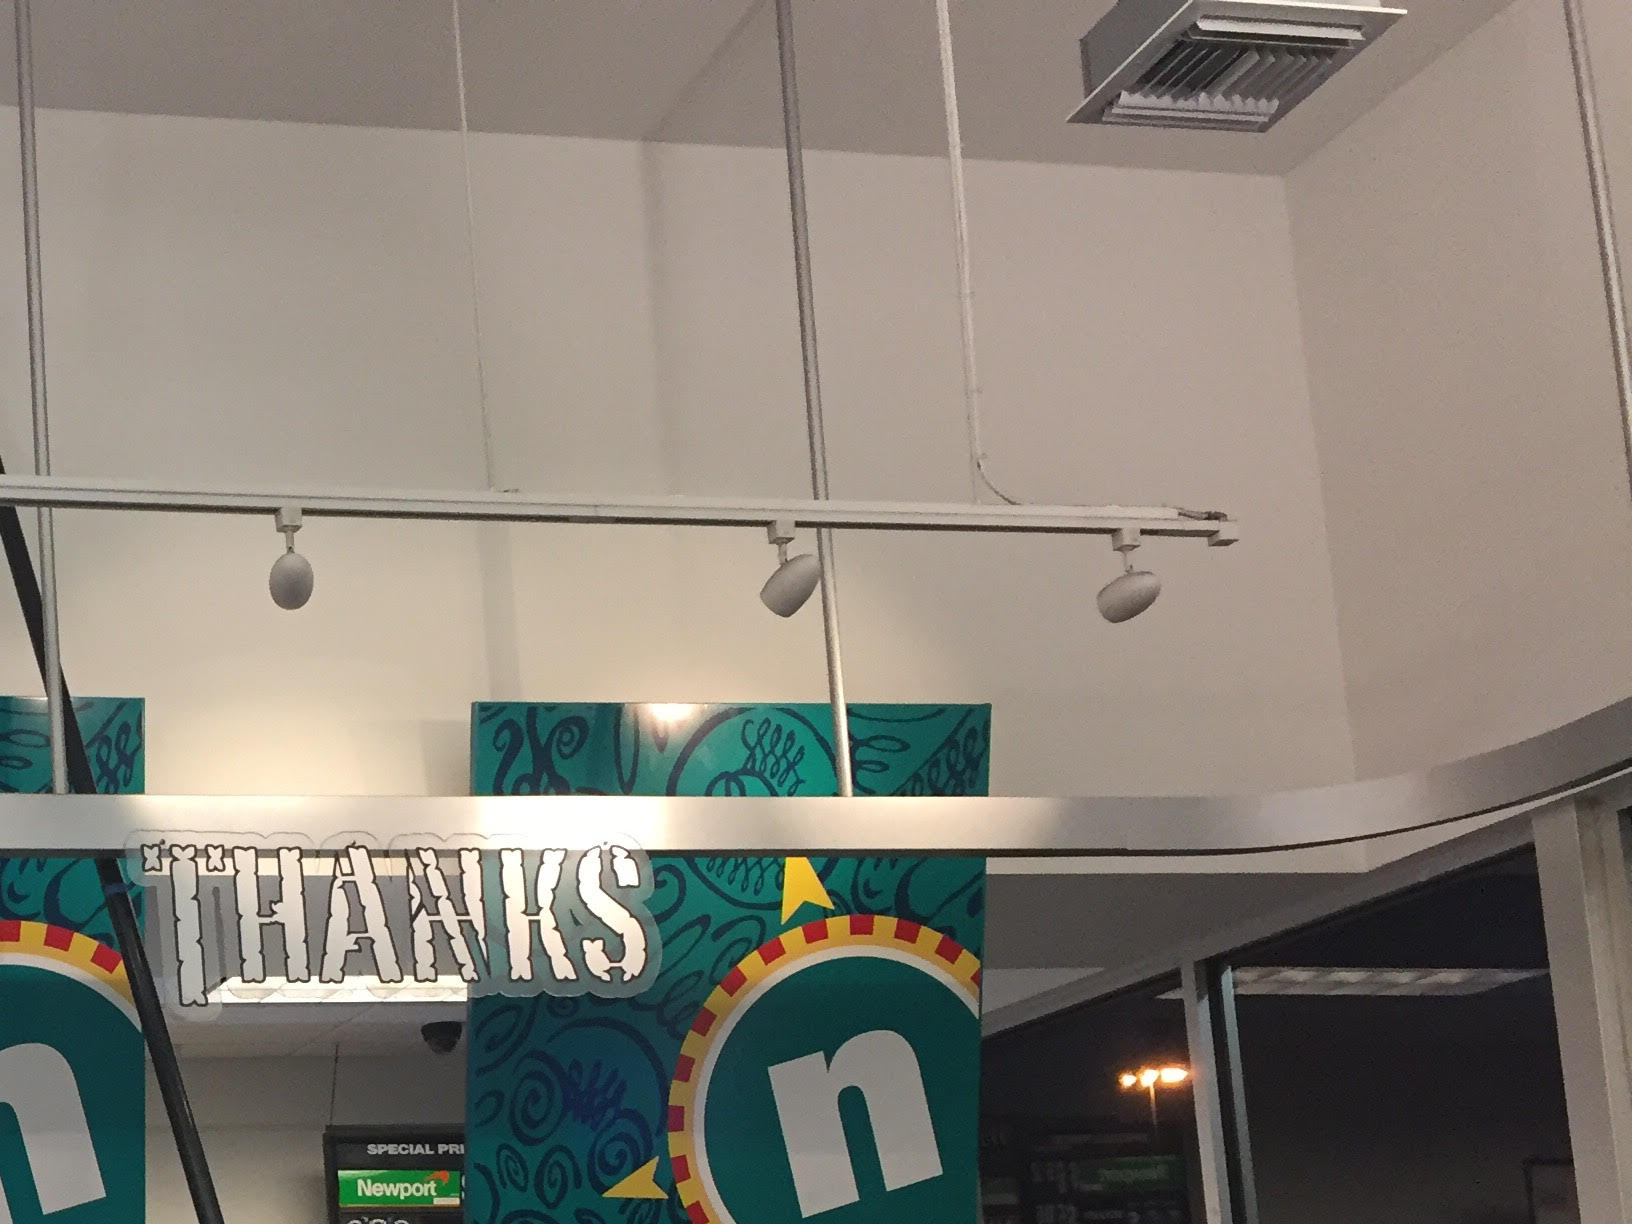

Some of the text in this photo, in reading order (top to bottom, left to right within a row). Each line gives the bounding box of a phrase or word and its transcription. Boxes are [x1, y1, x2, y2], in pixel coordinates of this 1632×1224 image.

[138, 840, 648, 1008] THANKS
[367, 1143, 465, 1155] SPECIAL PRI
[768, 1029, 943, 1219] n
[357, 1178, 437, 1200] Newport
